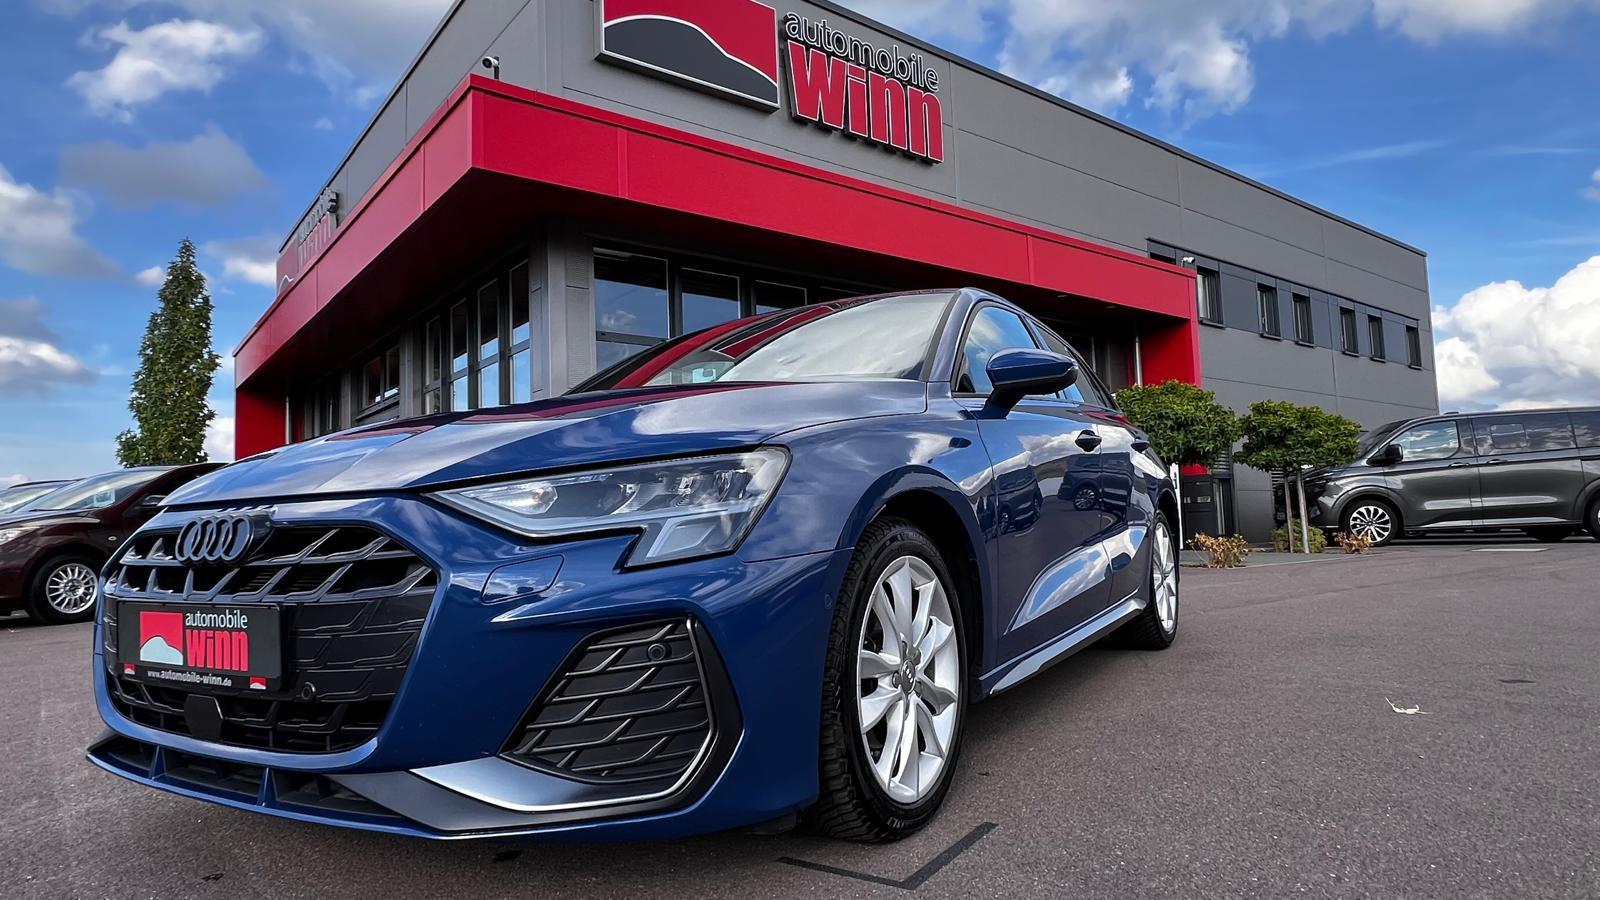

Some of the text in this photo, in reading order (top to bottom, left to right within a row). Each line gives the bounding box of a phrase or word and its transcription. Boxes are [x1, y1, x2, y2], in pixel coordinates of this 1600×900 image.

[786, 12, 939, 92] automobile
[185, 609, 248, 629] automobile
[147, 670, 232, 687] www.automobile-winn.de
